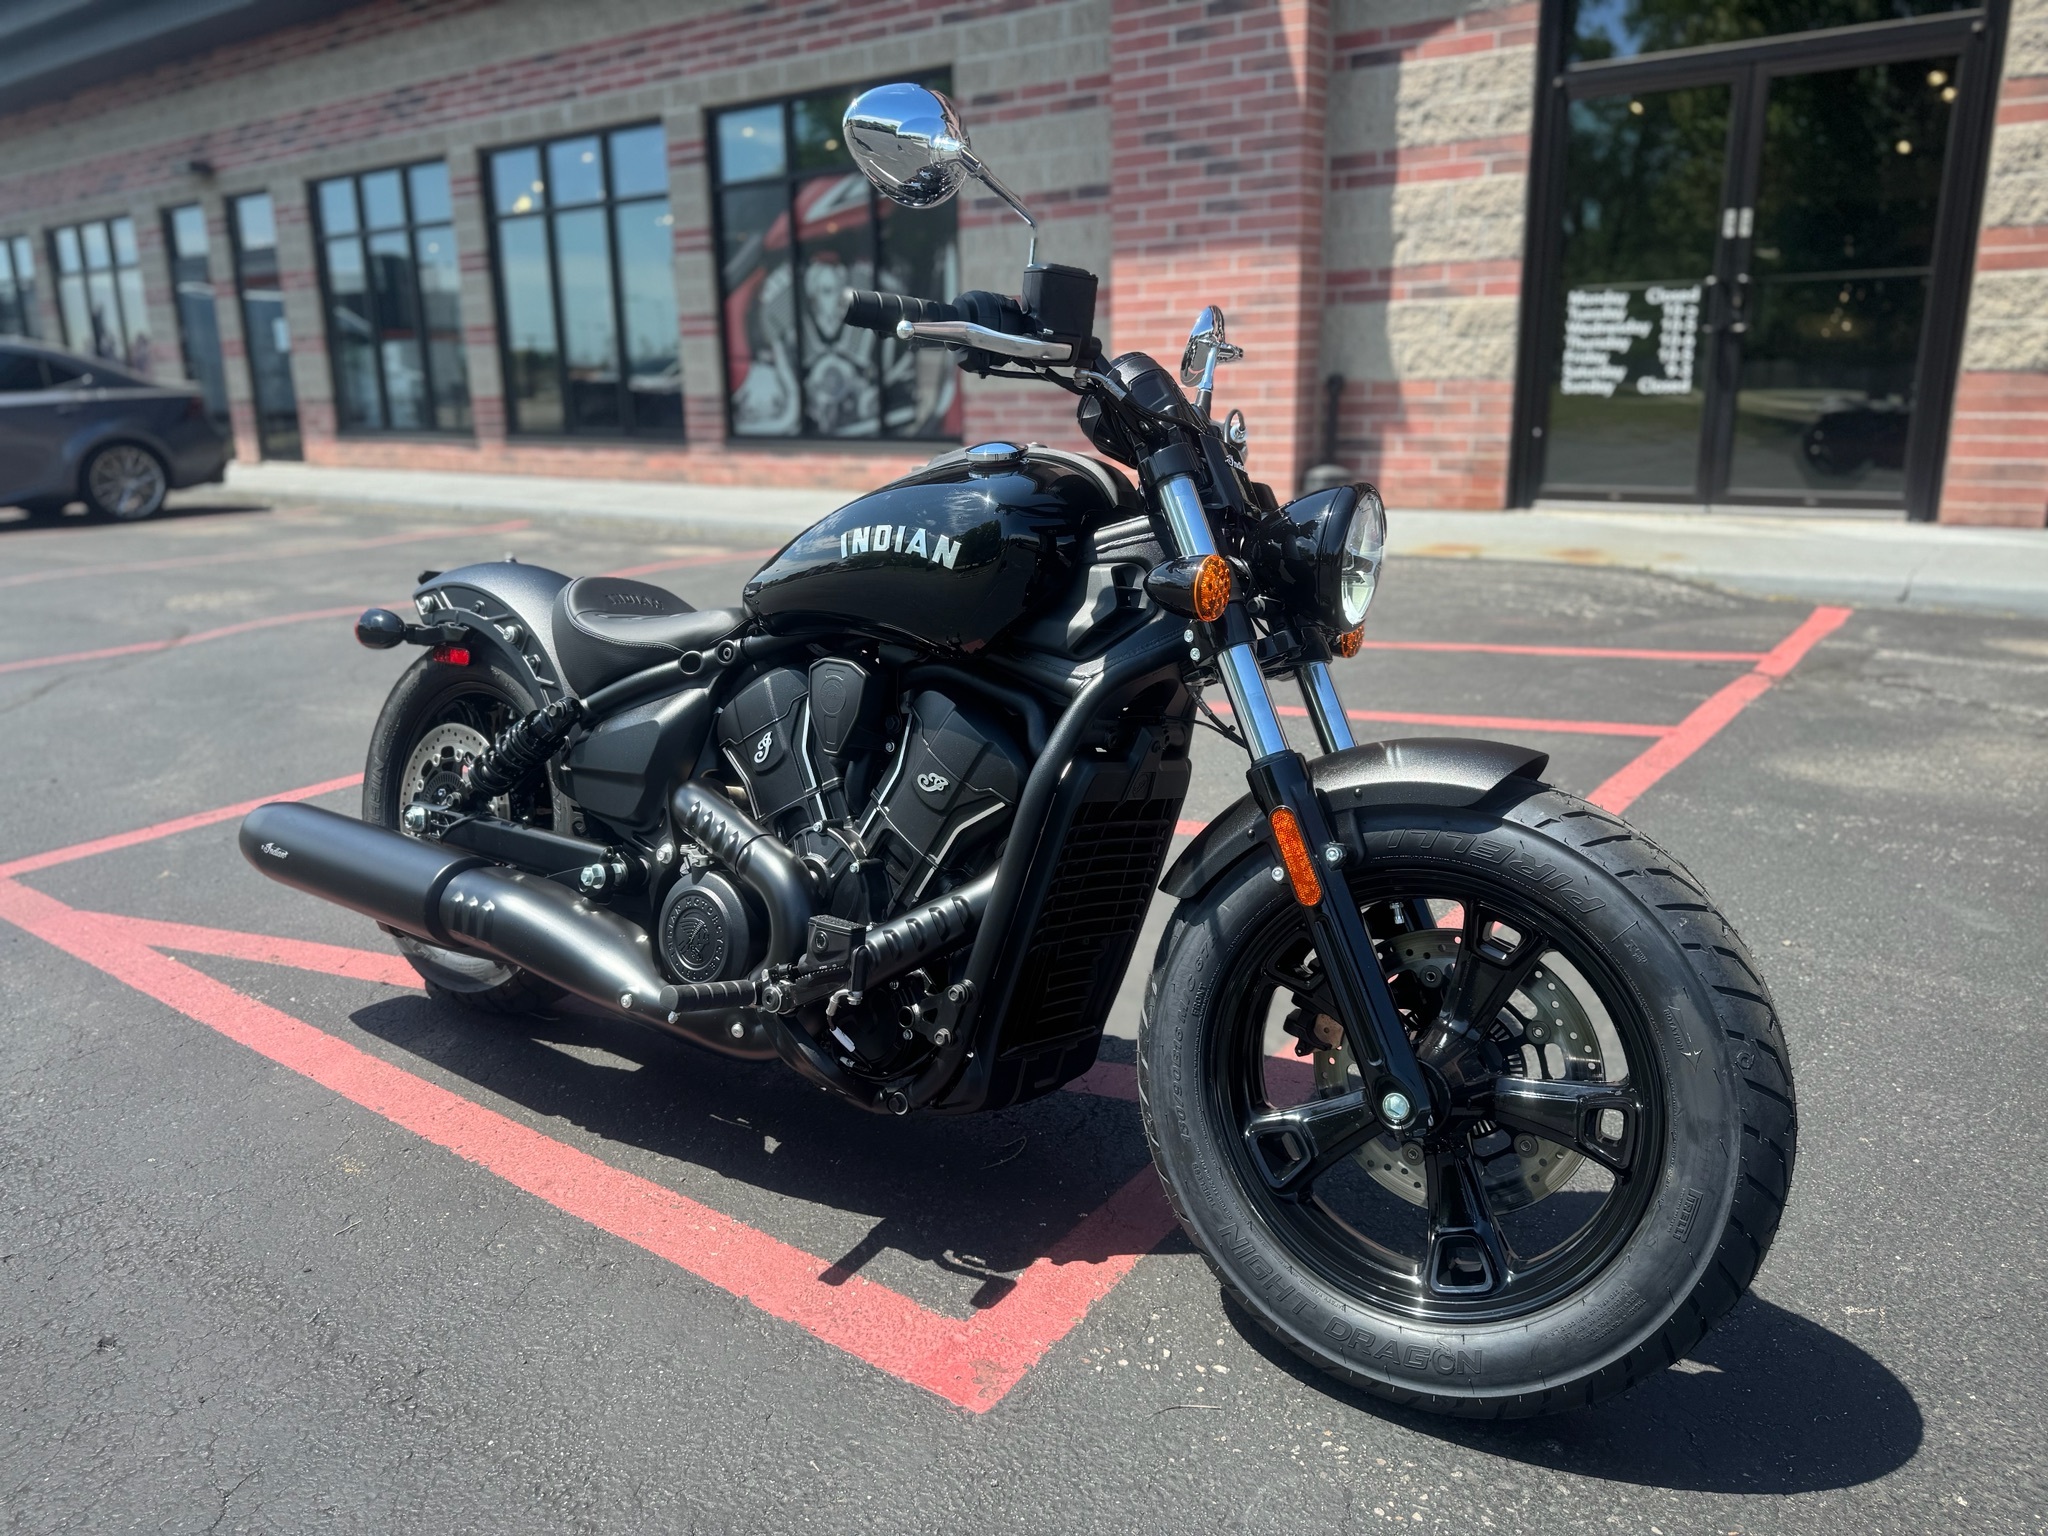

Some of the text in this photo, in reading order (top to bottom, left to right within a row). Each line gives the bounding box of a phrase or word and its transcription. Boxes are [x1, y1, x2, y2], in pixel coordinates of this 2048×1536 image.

[840, 524, 962, 570] INDIAN
[368, 756, 384, 825] NIGH
[1387, 829, 1606, 914] PIRELLI
[1191, 981, 1207, 1018] FRONT
[1663, 1008, 1684, 1051] ROTATION
[1217, 1222, 1317, 1316] NIGHT
[1323, 1315, 1482, 1376] DRAGON
